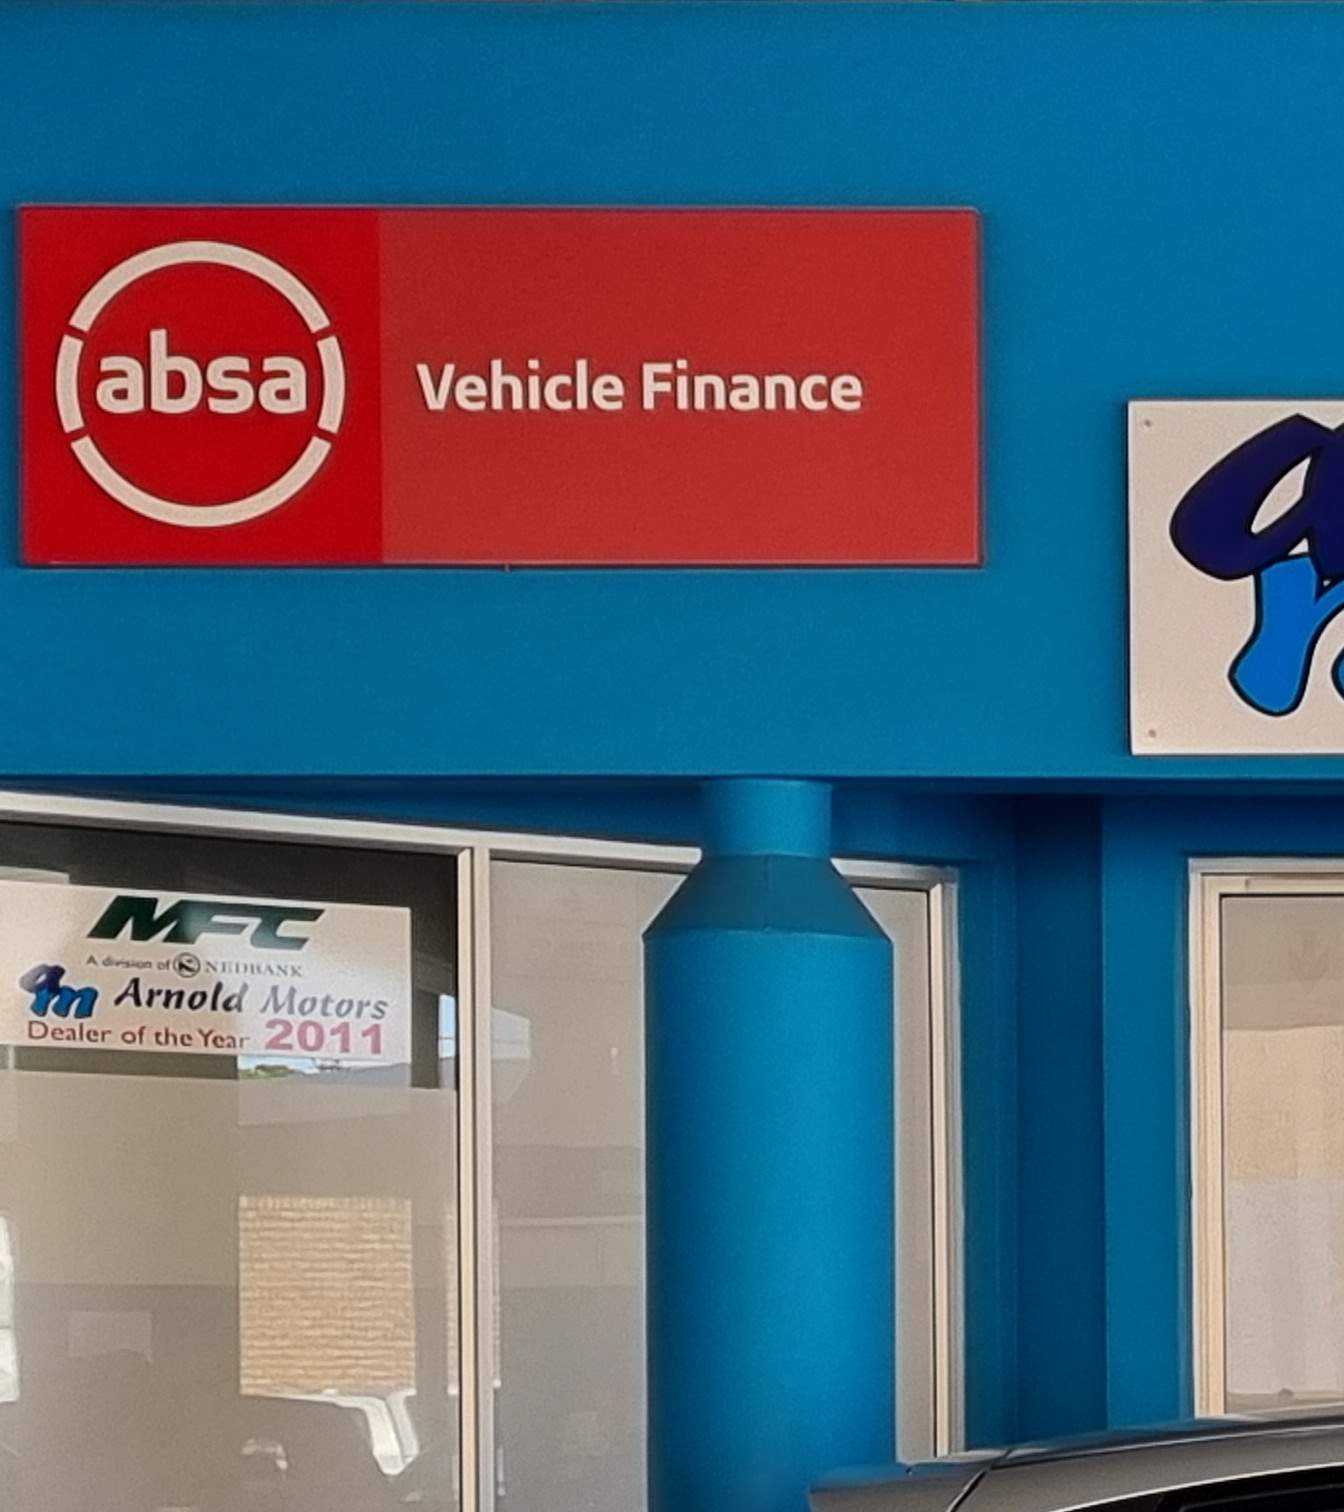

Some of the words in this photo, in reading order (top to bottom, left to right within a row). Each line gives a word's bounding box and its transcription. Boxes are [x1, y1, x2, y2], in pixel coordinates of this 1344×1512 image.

[95, 328, 308, 414] absa
[416, 359, 624, 412] Vehicle
[641, 359, 863, 412] Finance
[86, 895, 325, 951] MFC
[86, 955, 98, 966] A
[102, 955, 153, 969] division
[157, 959, 170, 971] of
[205, 960, 303, 977] NEDBANK
[114, 977, 249, 1013] Arnold
[259, 984, 389, 1020] Motors
[28, 1019, 113, 1042] Dealer
[121, 1025, 147, 1045] of
[154, 1027, 193, 1047] the
[198, 1028, 251, 1048] Year
[265, 1018, 382, 1055] 2011
